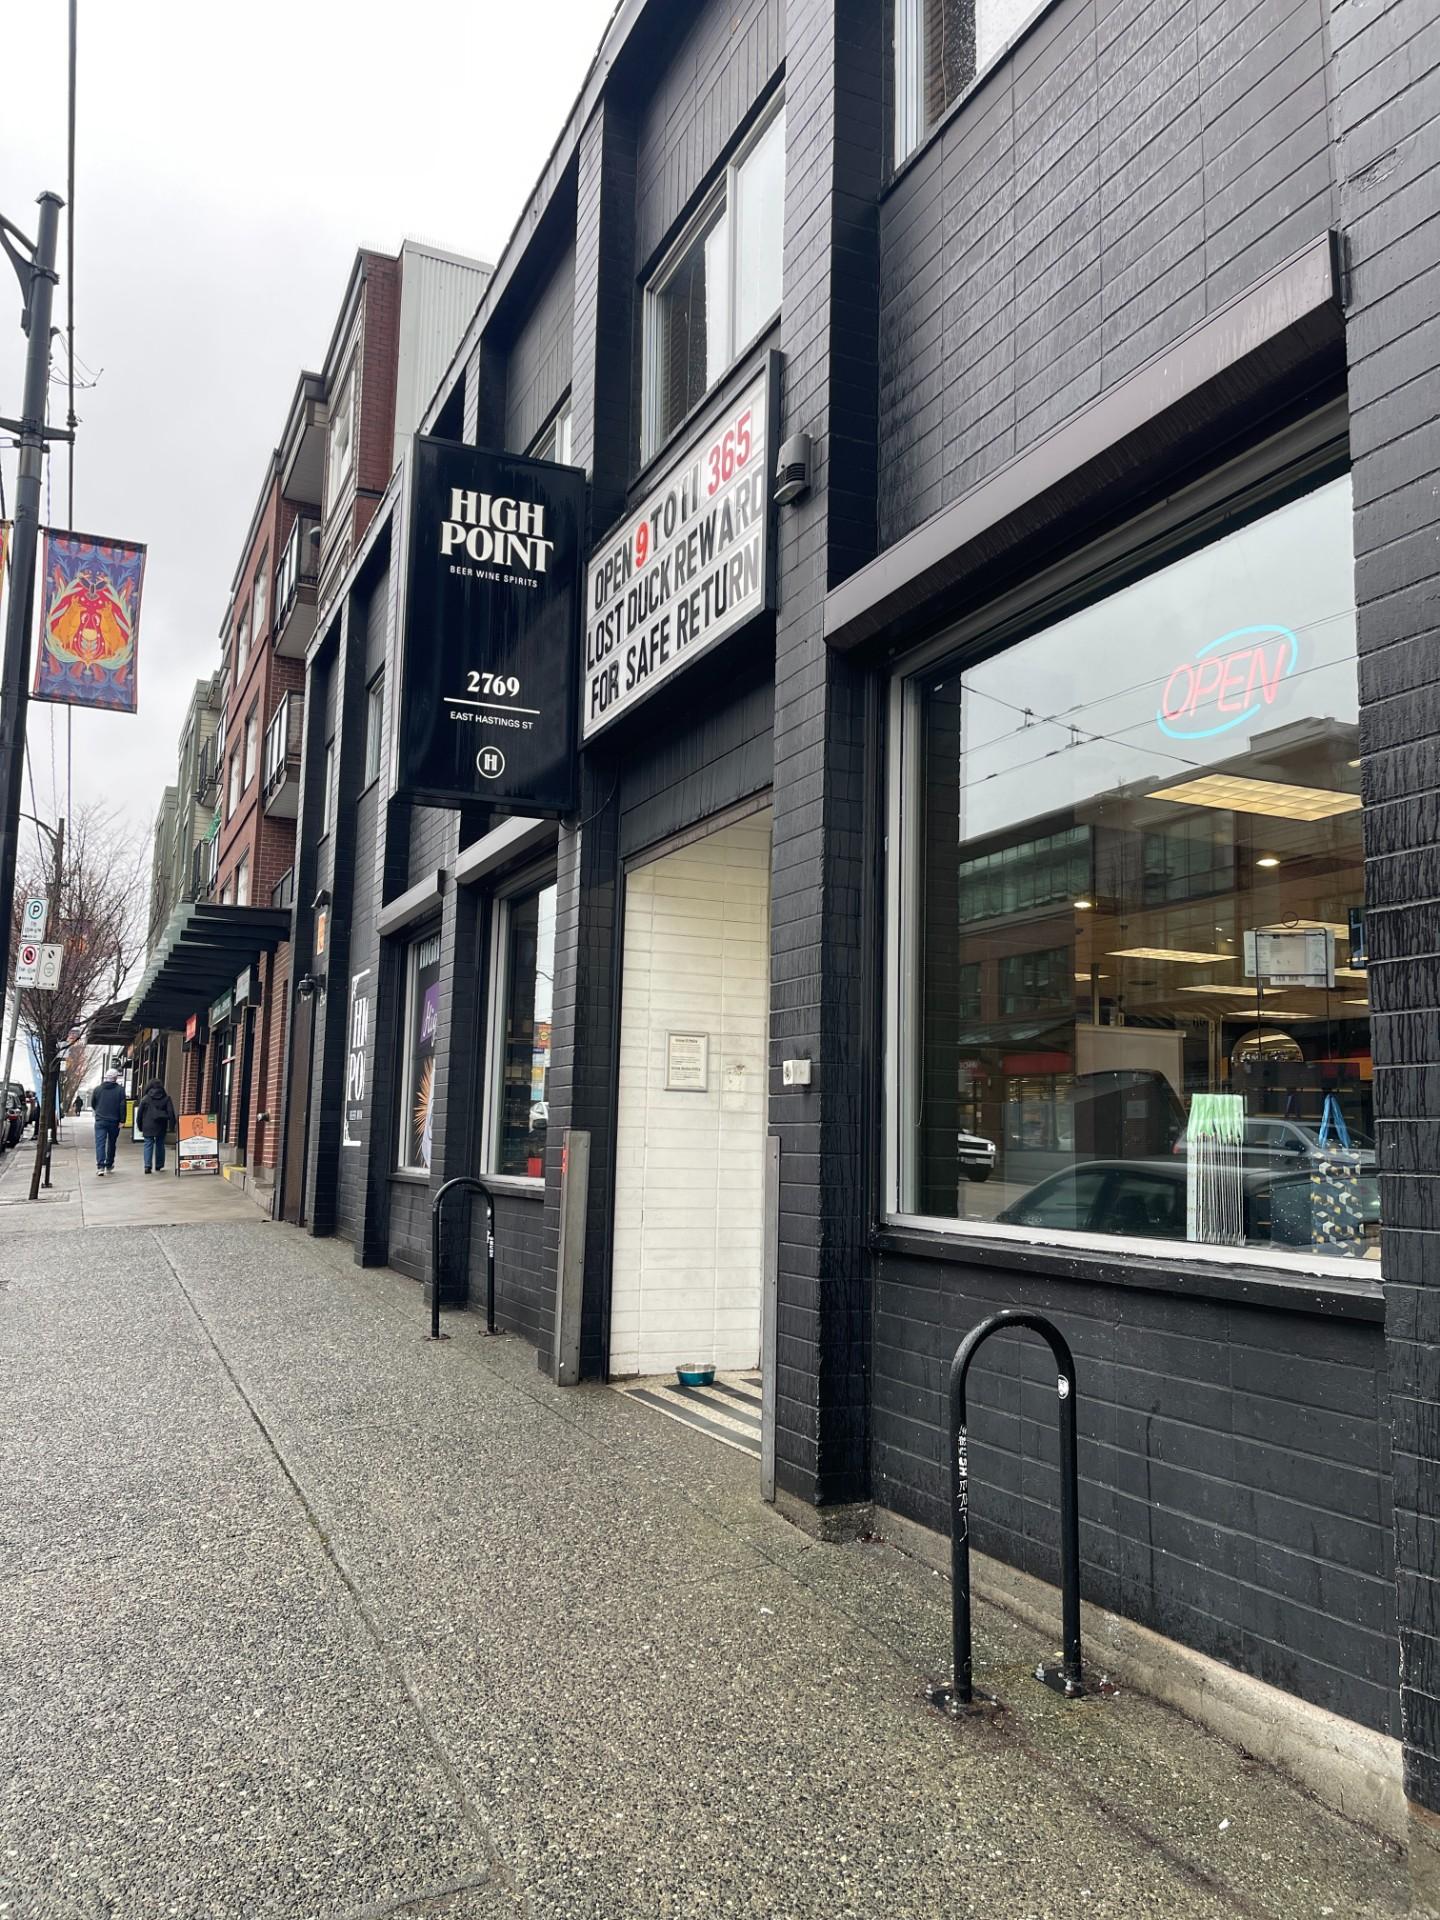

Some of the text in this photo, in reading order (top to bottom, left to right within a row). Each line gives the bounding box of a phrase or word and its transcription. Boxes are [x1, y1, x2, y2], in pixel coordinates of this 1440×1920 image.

[450, 488, 544, 537] HIGH
[594, 535, 633, 610] OPEN
[635, 521, 648, 568] 9
[650, 490, 677, 552] TO
[708, 410, 751, 496] 365
[440, 521, 554, 572] POINT
[587, 464, 763, 672] LOST DUCK REWARD
[449, 565, 538, 588] BEER WINE SPIRITS
[591, 534, 759, 720] FOR SAFE RETURN
[467, 670, 520, 697] 2769
[1162, 644, 1286, 719] OPEN
[450, 711, 534, 730] EAST HASTINGS ST
[484, 753, 498, 771] H
